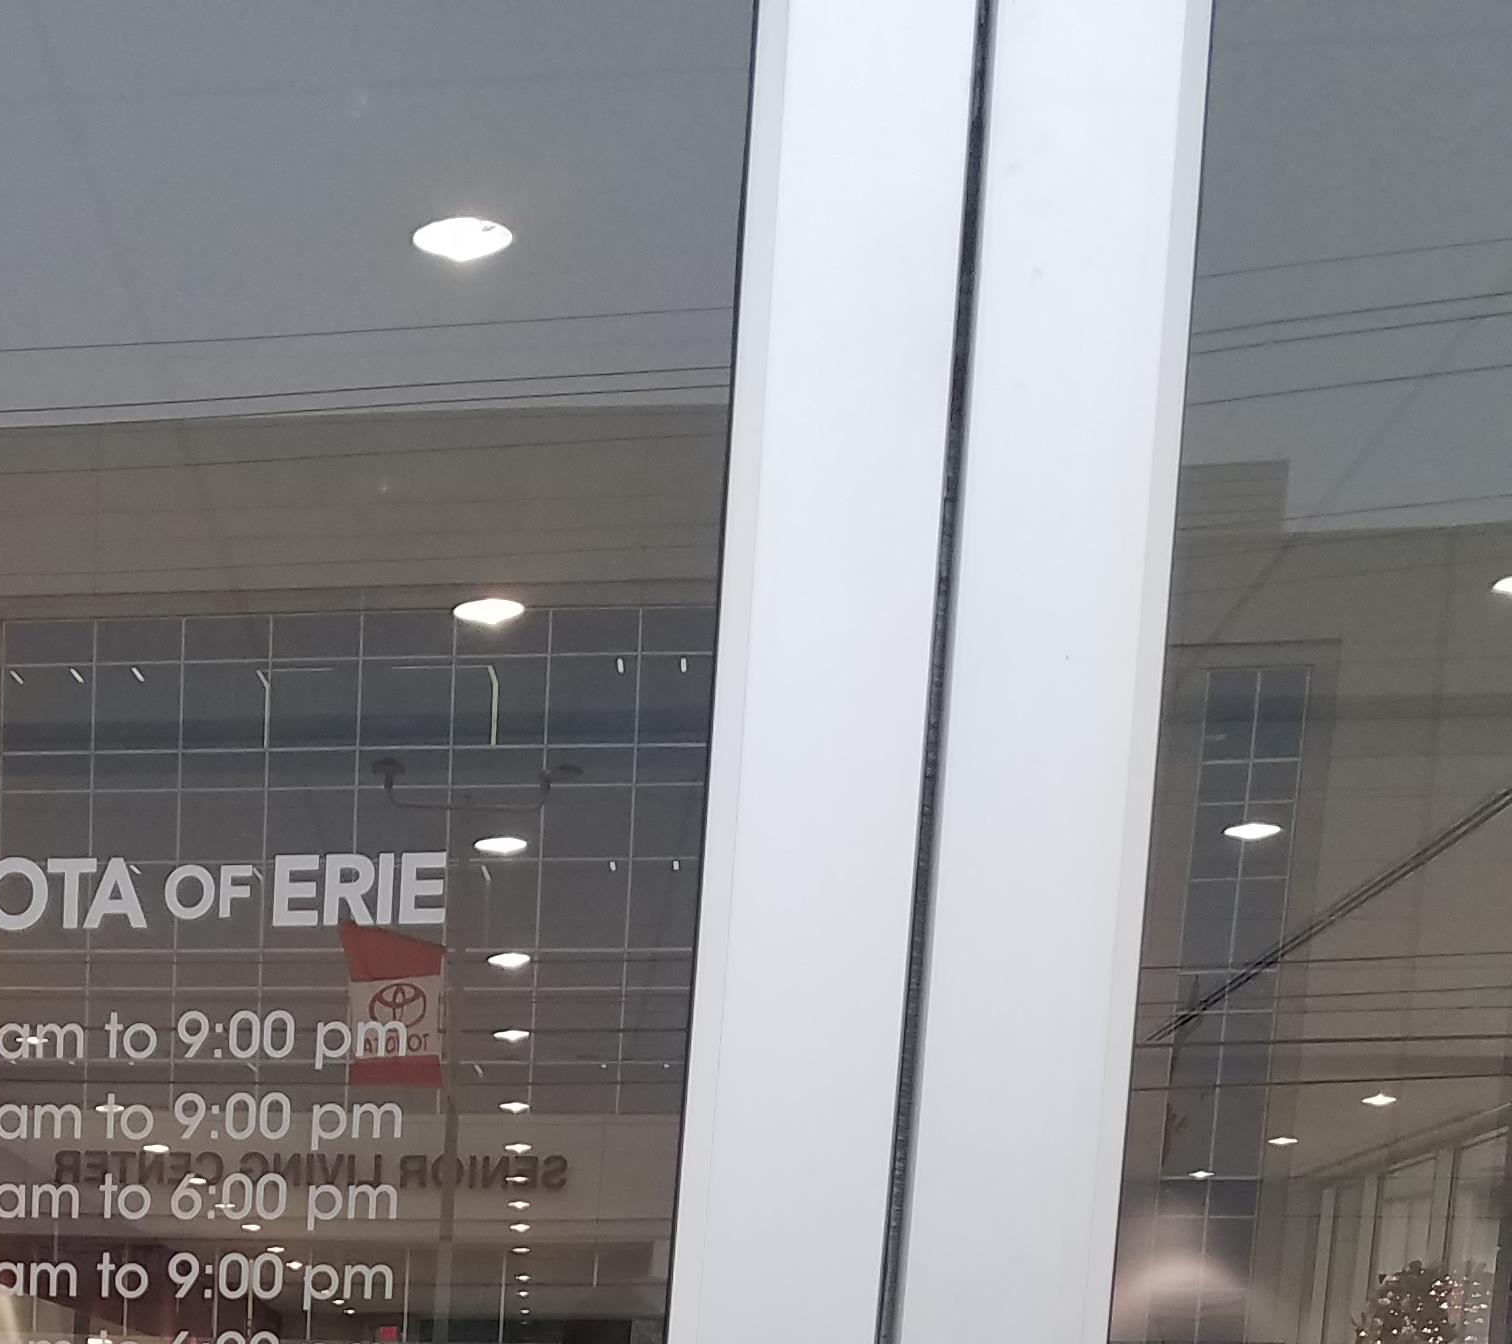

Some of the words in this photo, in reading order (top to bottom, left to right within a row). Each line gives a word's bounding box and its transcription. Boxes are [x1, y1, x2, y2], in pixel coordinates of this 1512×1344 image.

[164, 863, 255, 920] OF
[273, 851, 447, 927] ERIE
[105, 1012, 157, 1062] to
[178, 1011, 296, 1062] 9:00
[314, 1020, 408, 1073] pm
[102, 1093, 154, 1143] to
[174, 1093, 291, 1143] 9:00
[309, 1101, 403, 1154] pm
[98, 1173, 151, 1223] to
[170, 1173, 287, 1223] 6:00
[305, 1181, 399, 1234] pm
[97, 1253, 150, 1303] to
[168, 1250, 287, 1303] 9:00
[300, 1260, 394, 1312] pm
